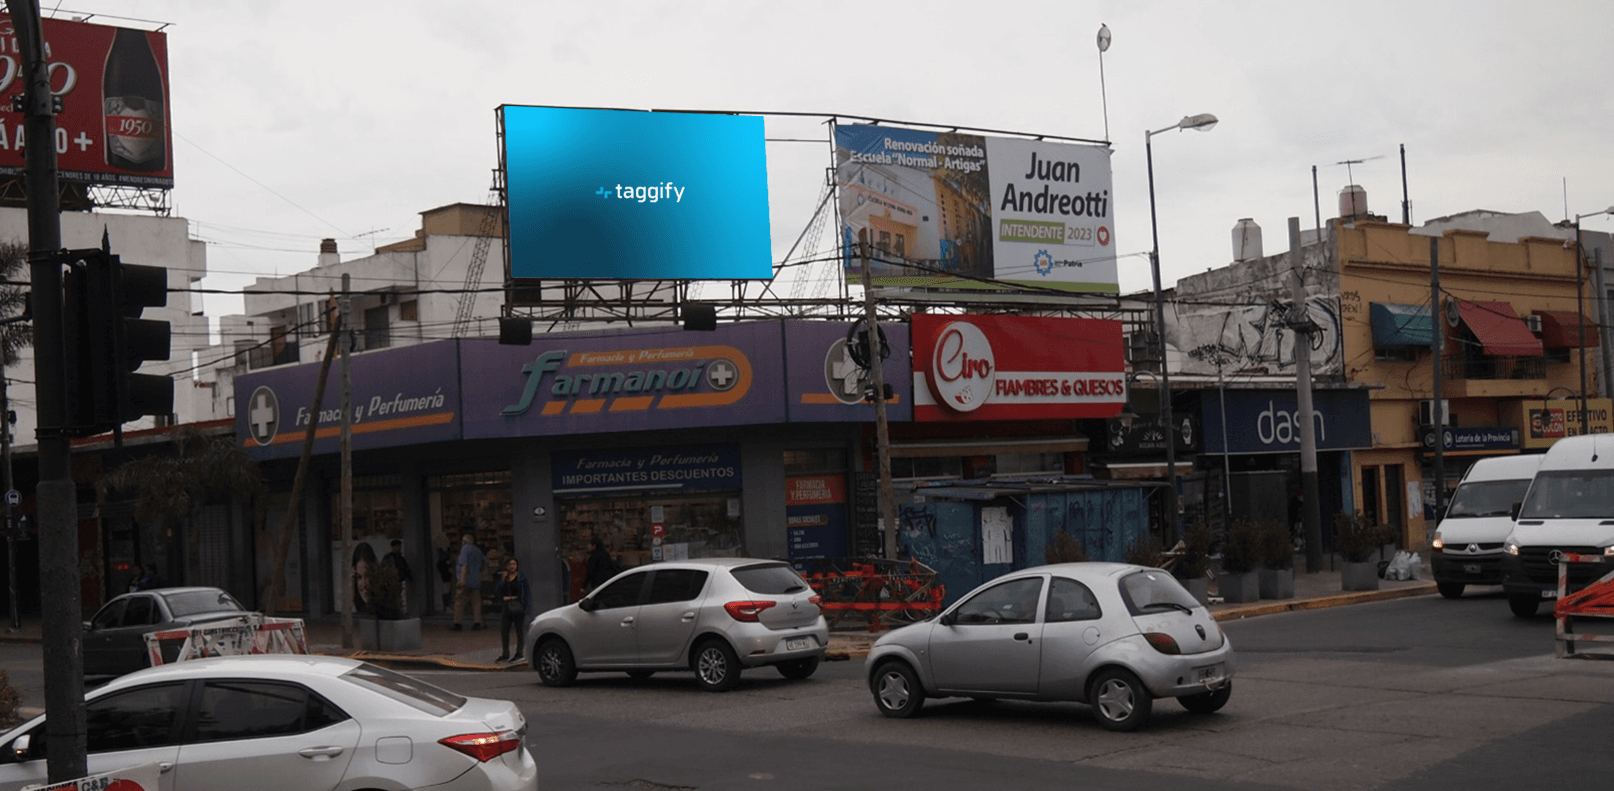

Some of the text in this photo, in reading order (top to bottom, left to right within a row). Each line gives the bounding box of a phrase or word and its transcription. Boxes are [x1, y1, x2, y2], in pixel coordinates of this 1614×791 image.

[119, 118, 152, 135] 1950
[884, 138, 984, 158] Renovación soñada
[850, 151, 892, 164] Escuela
[1025, 152, 1080, 183] Juan
[615, 182, 685, 203] taggify
[1001, 183, 1108, 218] Andreotti
[1001, 223, 1092, 241] INTENDENTE 2023
[580, 348, 694, 364] Farmacia y Perfumería
[937, 329, 993, 382] Ciro
[996, 379, 1124, 396] FIAMBRES & QUESOS
[354, 404, 364, 423] y
[367, 387, 445, 416] Perfumería
[1488, 432, 1510, 442] Provincia
[576, 452, 719, 470] Farmacia y Perfumería
[562, 466, 734, 485] IMPORTANTES DESCUENTOS
